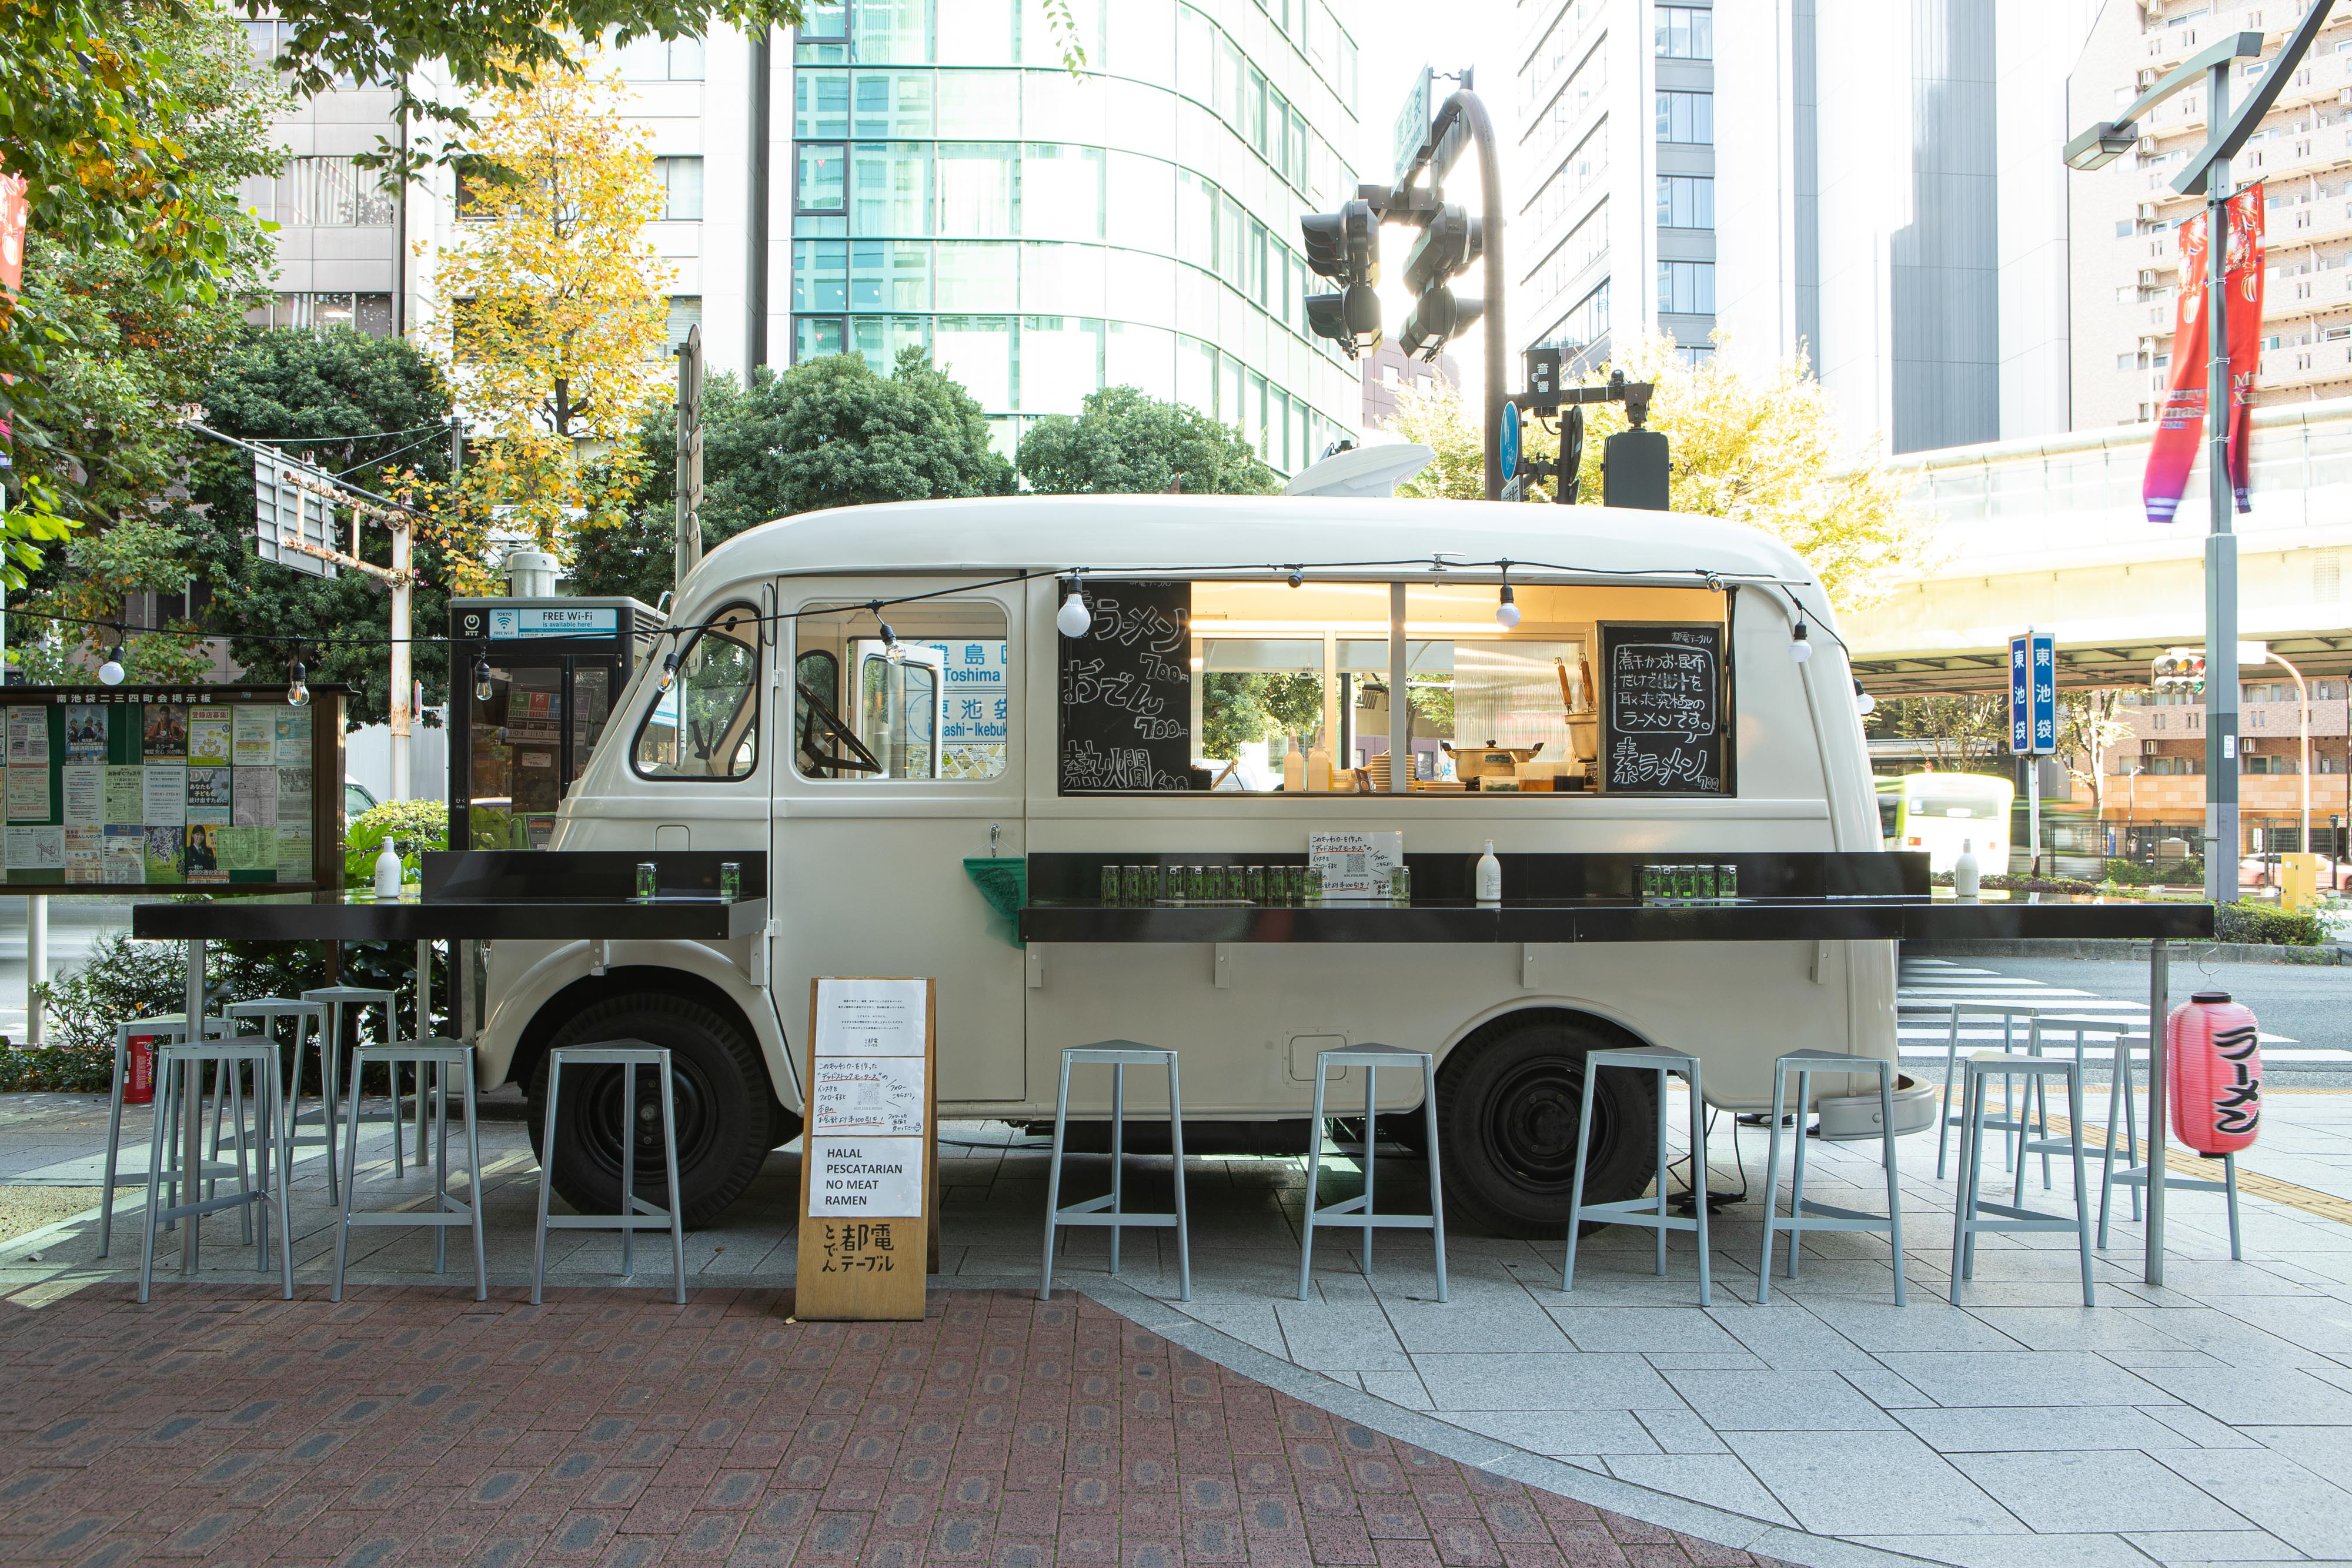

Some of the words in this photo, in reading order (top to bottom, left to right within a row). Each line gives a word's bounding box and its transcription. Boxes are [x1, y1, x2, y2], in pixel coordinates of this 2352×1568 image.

[1536, 362, 1549, 393] 音響
[543, 611, 564, 621] FREE
[567, 611, 593, 621] Wi-Fi
[944, 667, 1000, 682] Toshima
[1063, 658, 1164, 716] おでん
[2035, 647, 2052, 739] 東池袋
[56, 694, 211, 703] 南池袋二三四町会掲示板
[2014, 650, 2026, 741] 東池袋
[1613, 736, 1707, 785] 素ラーメン
[189, 768, 214, 783] DV
[827, 1148, 863, 1158] HALAL
[826, 1164, 903, 1174] PESCATARIAN
[826, 1179, 844, 1190] NO
[846, 1179, 879, 1190] MEAT
[825, 1195, 867, 1206] RAMEN
[839, 1223, 894, 1251] 都電
[821, 1224, 838, 1273] とでん
[841, 1255, 894, 1273] テーブル
